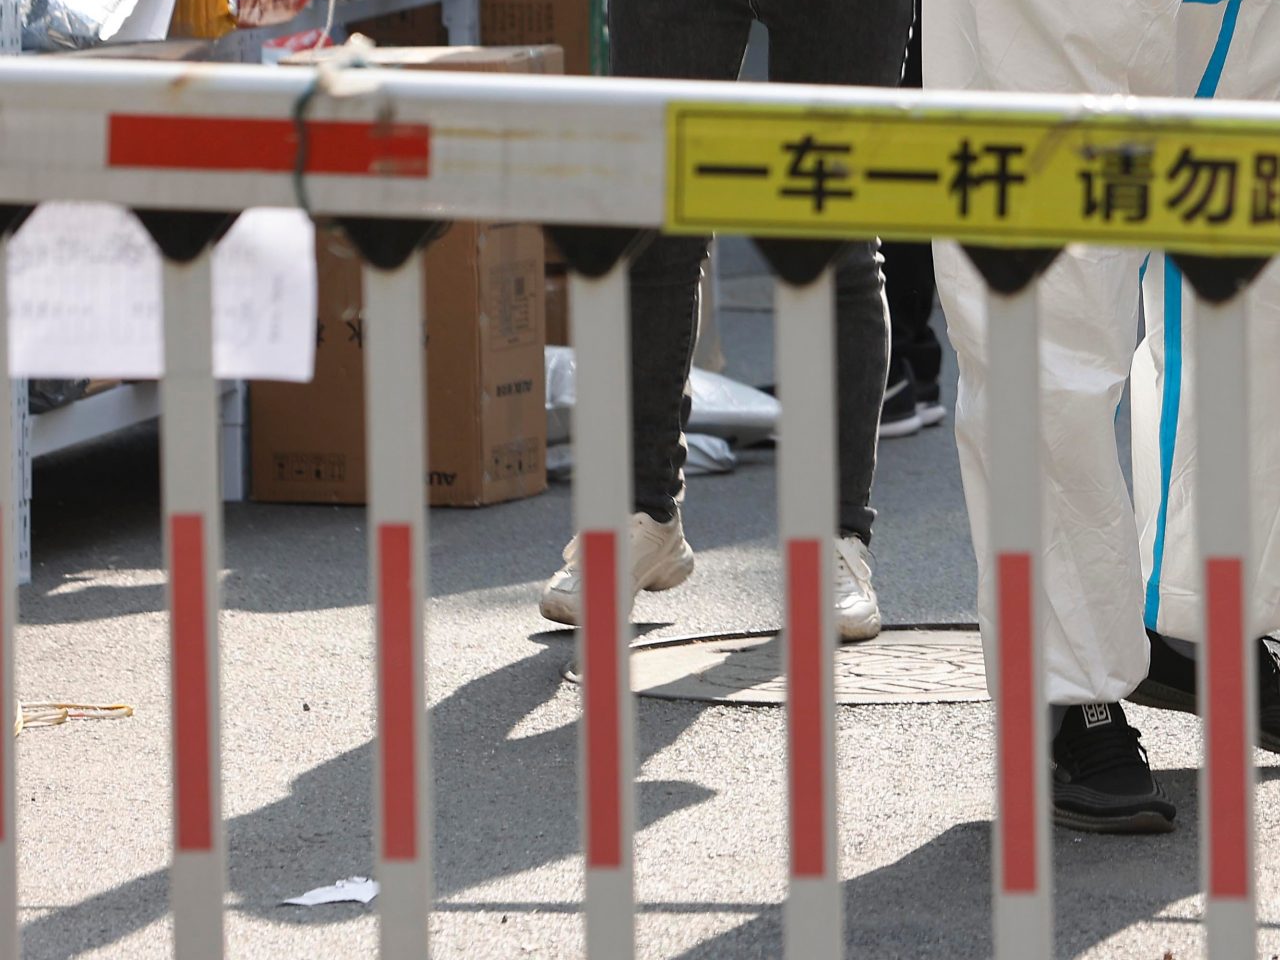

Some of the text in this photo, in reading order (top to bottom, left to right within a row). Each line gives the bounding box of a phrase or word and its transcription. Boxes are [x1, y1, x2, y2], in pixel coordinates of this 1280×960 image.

[694, 135, 1027, 218] 一车一杆
[428, 470, 457, 486] AU
